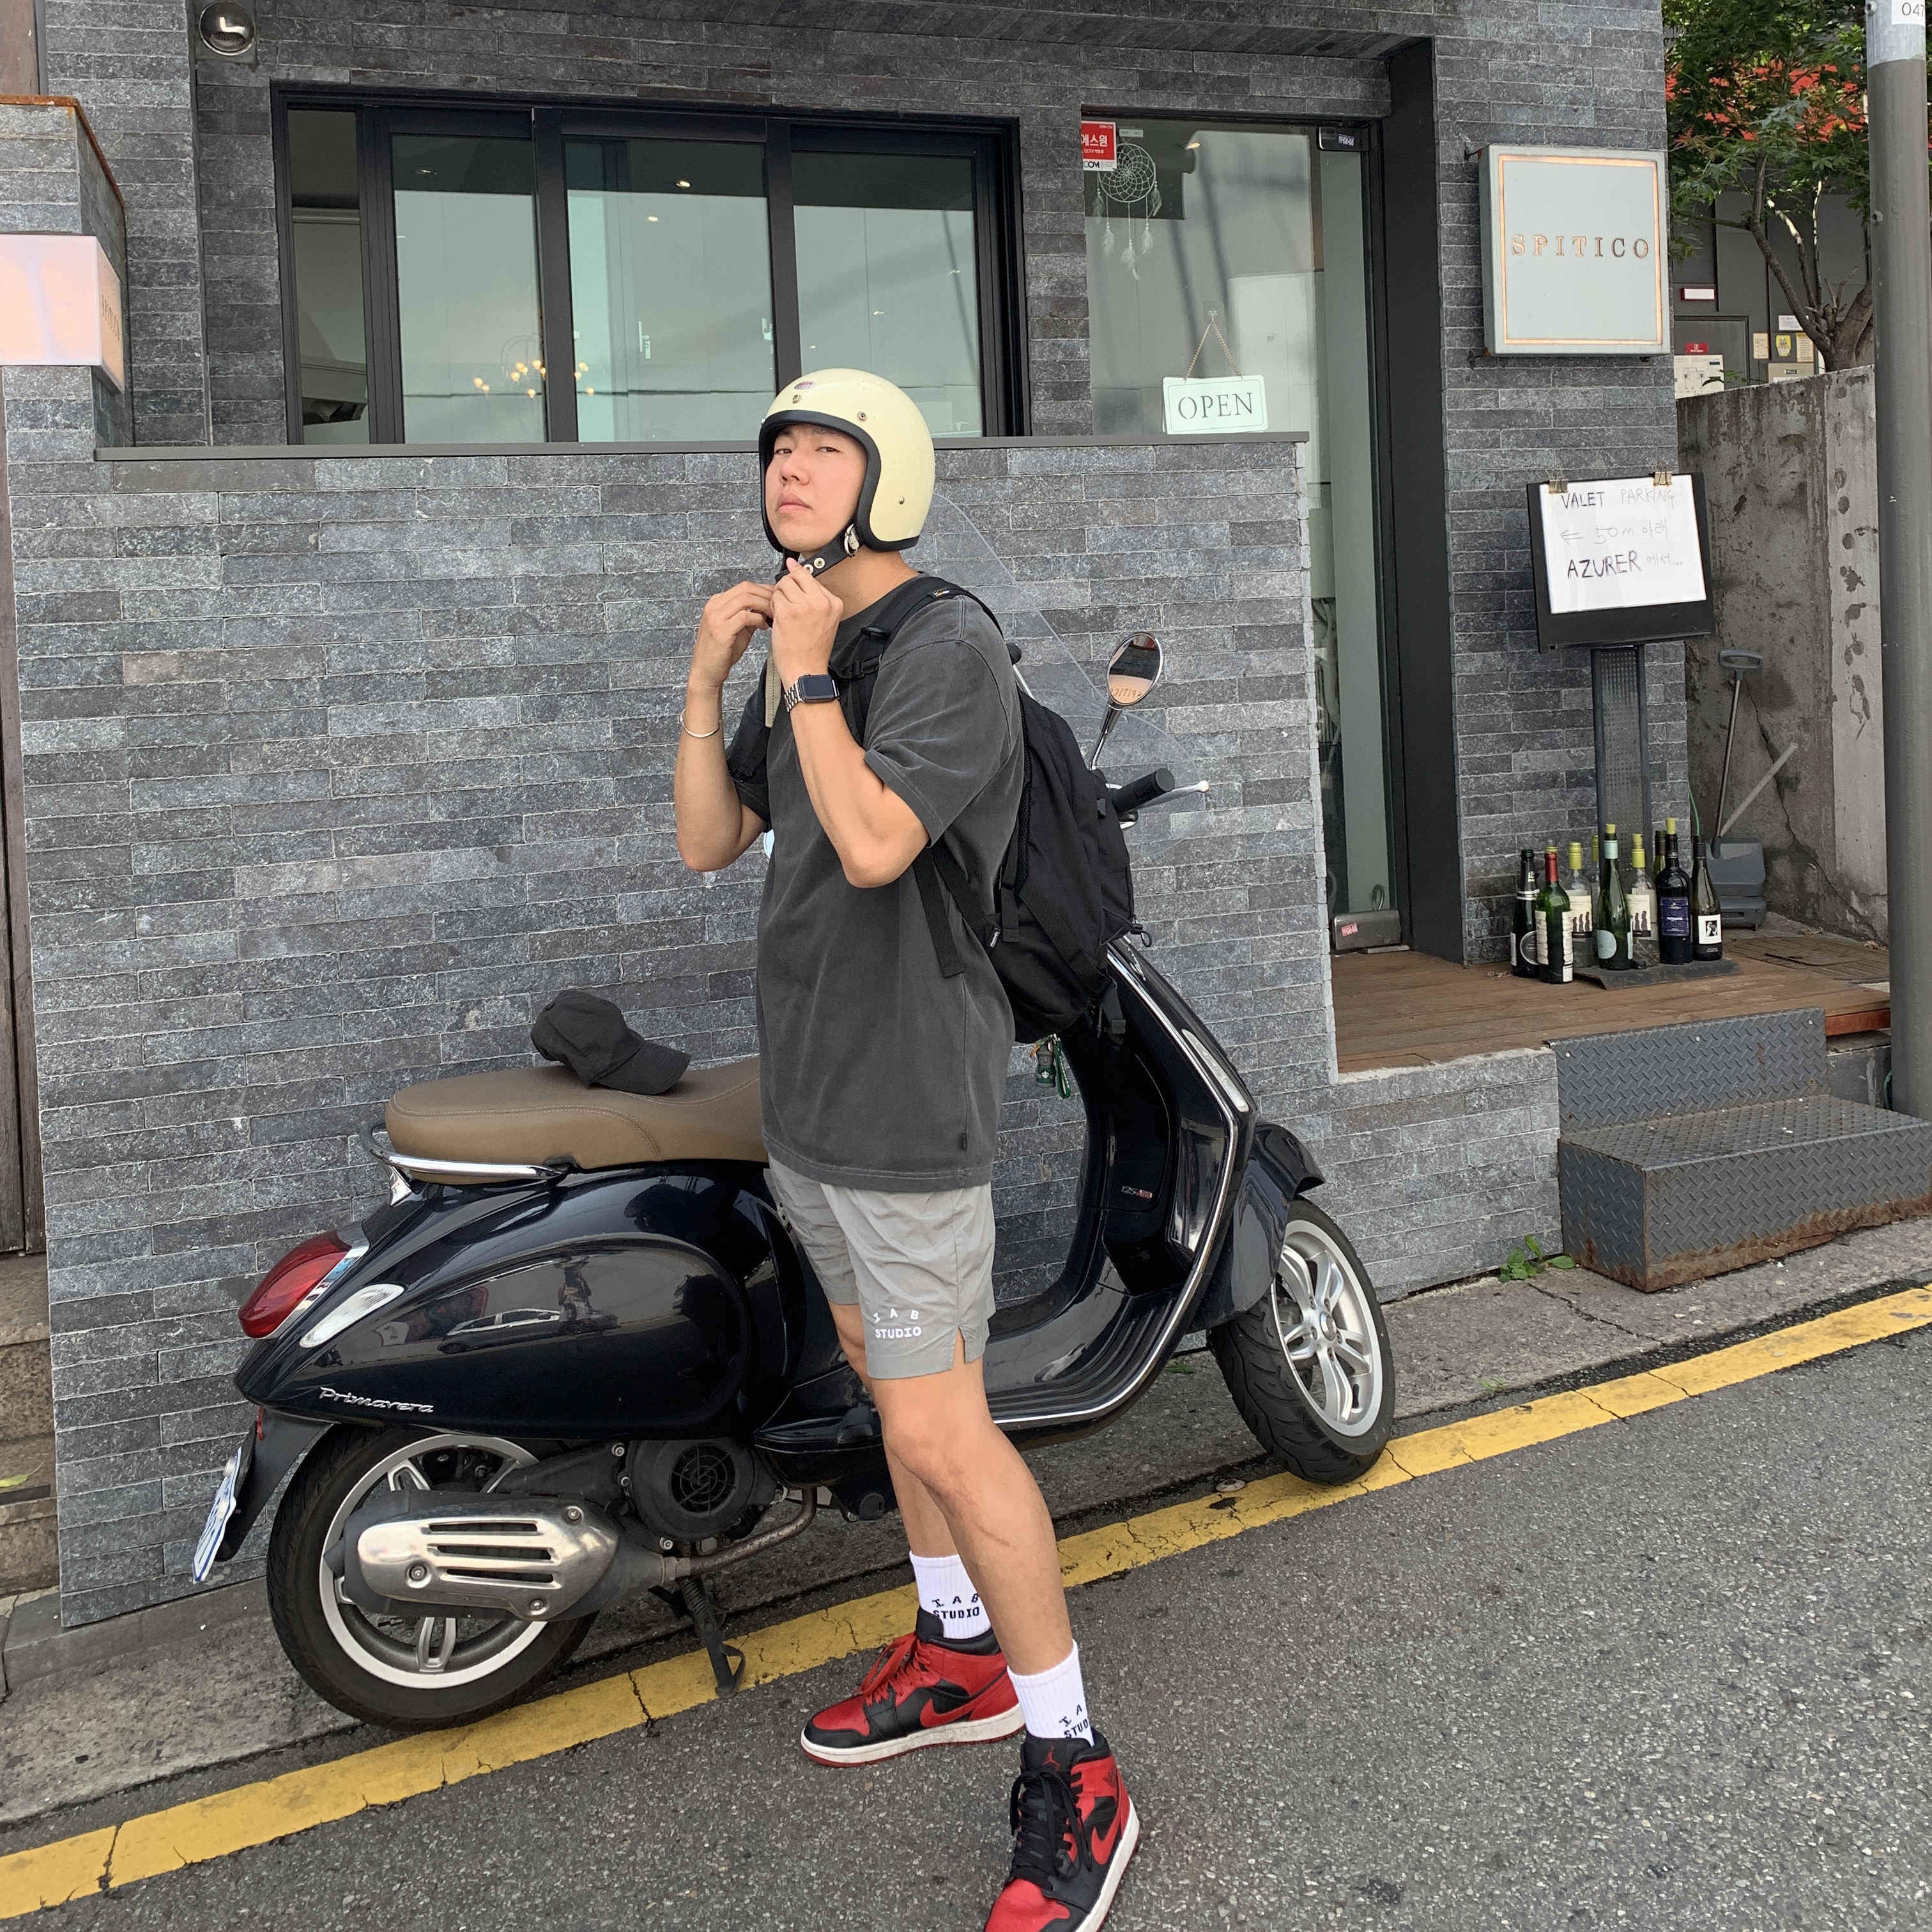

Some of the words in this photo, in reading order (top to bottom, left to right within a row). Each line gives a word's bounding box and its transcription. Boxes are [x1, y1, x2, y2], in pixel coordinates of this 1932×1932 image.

[1511, 234, 1649, 259] SPITICO
[1178, 392, 1253, 420] OPEN
[1561, 491, 1606, 509] VALET
[1620, 487, 1676, 509] PARKING
[1642, 517, 1668, 539] 아래
[1567, 549, 1642, 579] AZURER
[875, 1326, 922, 1339] STUDIO
[319, 1386, 434, 1413] Primavera
[933, 1606, 979, 1619] STUDIO
